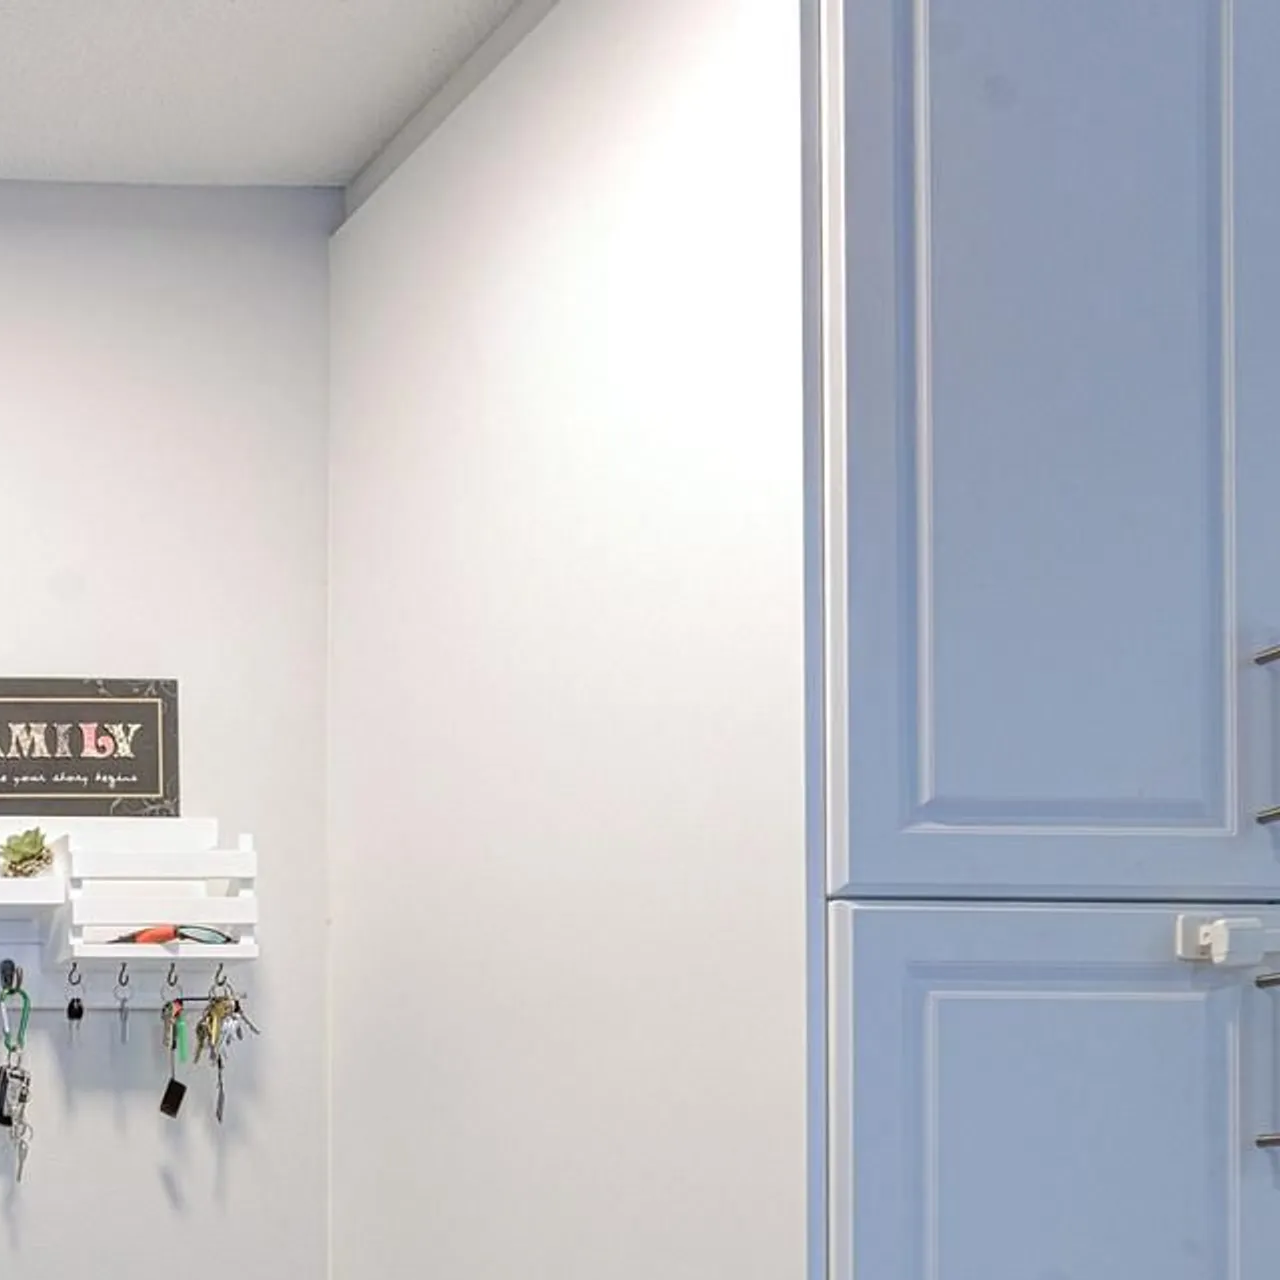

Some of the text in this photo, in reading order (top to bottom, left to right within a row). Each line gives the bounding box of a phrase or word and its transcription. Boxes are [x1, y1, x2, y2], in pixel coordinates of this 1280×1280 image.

[13, 773, 47, 788] your
[52, 771, 89, 787] story
[95, 771, 138, 789] begins
